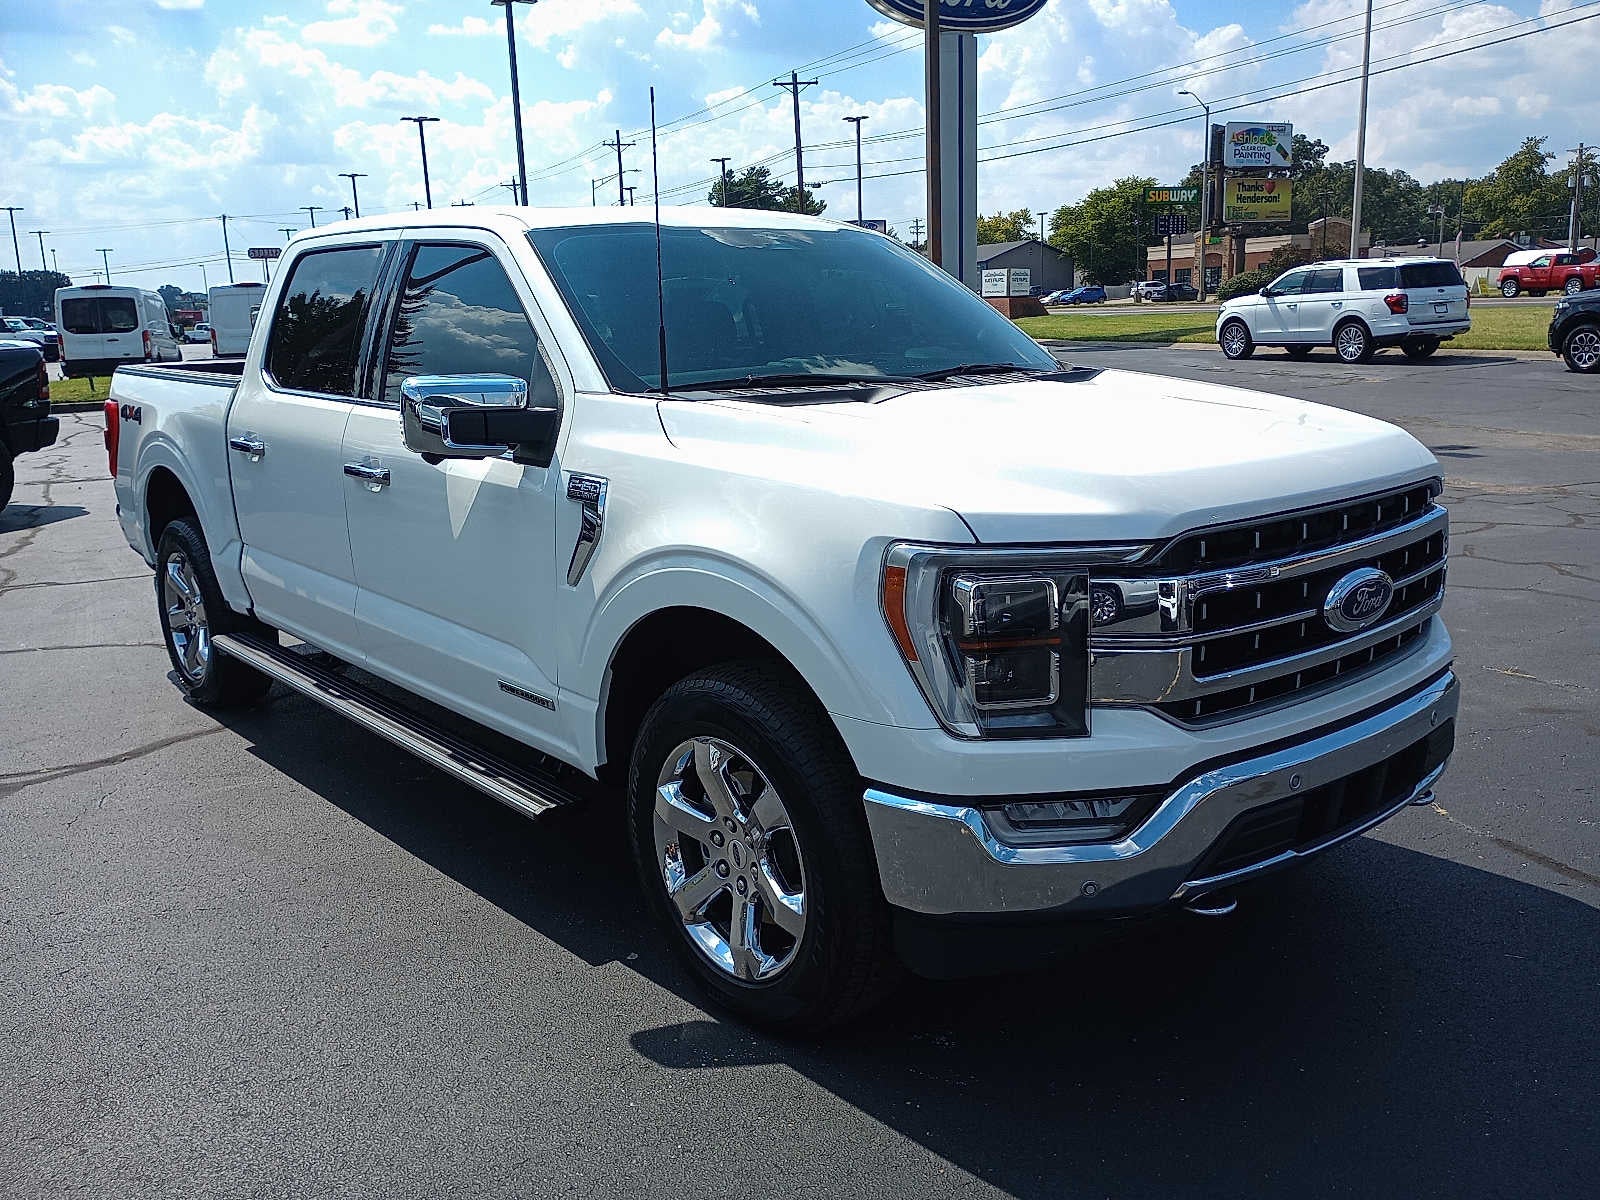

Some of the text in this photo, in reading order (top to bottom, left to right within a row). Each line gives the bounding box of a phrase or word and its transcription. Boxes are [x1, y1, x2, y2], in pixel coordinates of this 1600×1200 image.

[1229, 131, 1278, 145] Ashlock's
[1237, 181, 1264, 193] Thanks
[1147, 189, 1196, 202] SUBWAY
[1236, 194, 1280, 204] Henderson!
[1353, 586, 1384, 615] Ford
